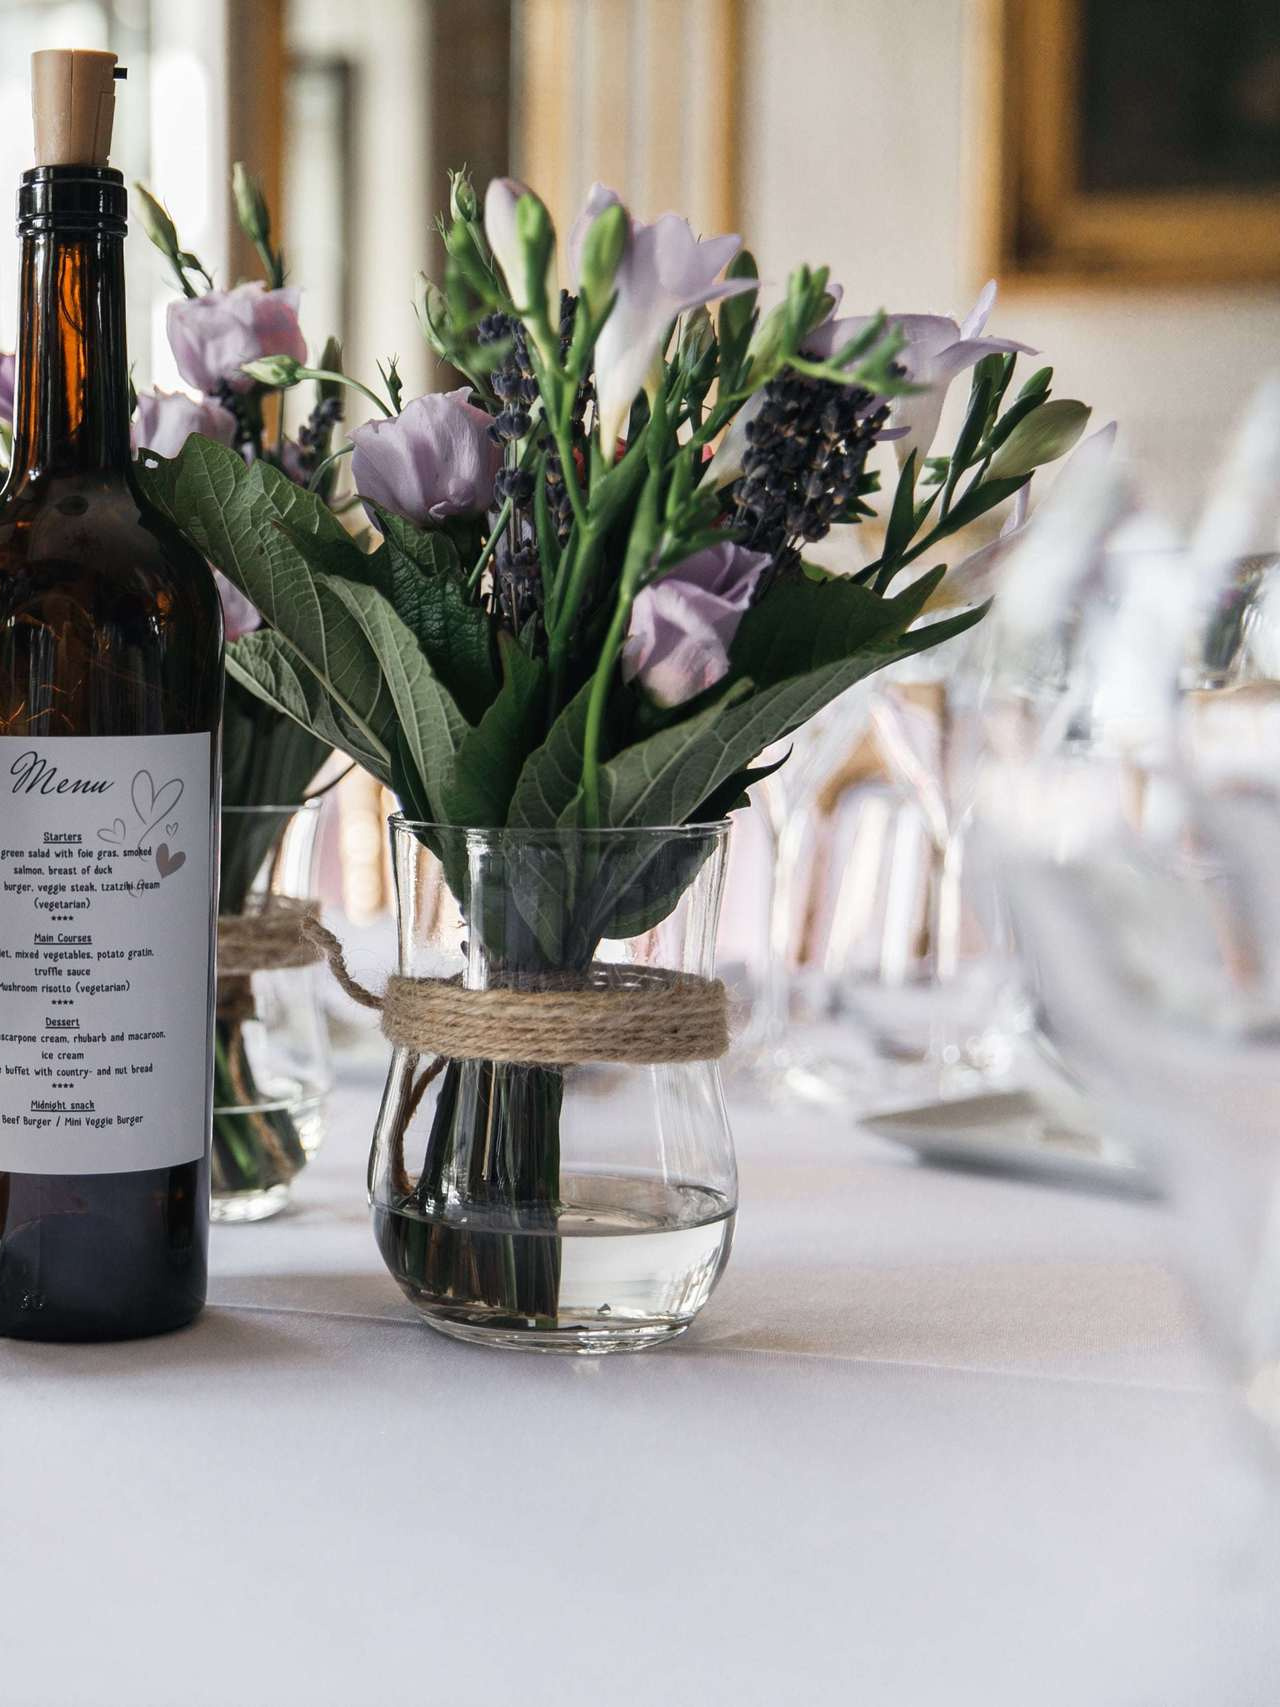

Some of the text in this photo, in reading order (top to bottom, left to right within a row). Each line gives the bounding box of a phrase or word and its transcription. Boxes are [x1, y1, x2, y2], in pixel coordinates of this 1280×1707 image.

[10, 750, 115, 795] Menu
[43, 832, 82, 842] Starters
[1, 848, 24, 860] green
[28, 848, 50, 858] salad
[54, 848, 74, 858] with
[77, 848, 93, 858] foie
[122, 846, 152, 857] smoked
[48, 866, 77, 875] breast
[81, 865, 92, 875] of
[94, 865, 113, 874] duck
[37, 882, 67, 895] veggie
[136, 880, 161, 890] cream
[33, 897, 91, 911] (vegetarian)
[34, 933, 93, 945] Main Courses
[15, 949, 39, 960] mixed
[97, 949, 125, 962] potato
[34, 967, 91, 977] truffle sauce
[41, 983, 72, 993] risotto
[75, 980, 131, 995] (vegetarian)
[45, 1017, 80, 1029] Dessert
[73, 1032, 107, 1043] rhubarb
[110, 1032, 125, 1042] and
[41, 1051, 85, 1060] ice cream
[5, 1065, 31, 1076] buffet
[34, 1066, 53, 1078] with
[96, 1066, 111, 1076] and
[114, 1065, 128, 1075] nut
[131, 1063, 153, 1074] bread
[30, 1100, 96, 1112] Midnight snack
[2, 1114, 21, 1125] Beef
[23, 1115, 52, 1129] Burger
[55, 1116, 61, 1127] /
[64, 1116, 82, 1127] Mini
[85, 1116, 113, 1128] Veggie
[116, 1114, 144, 1127] Burger
